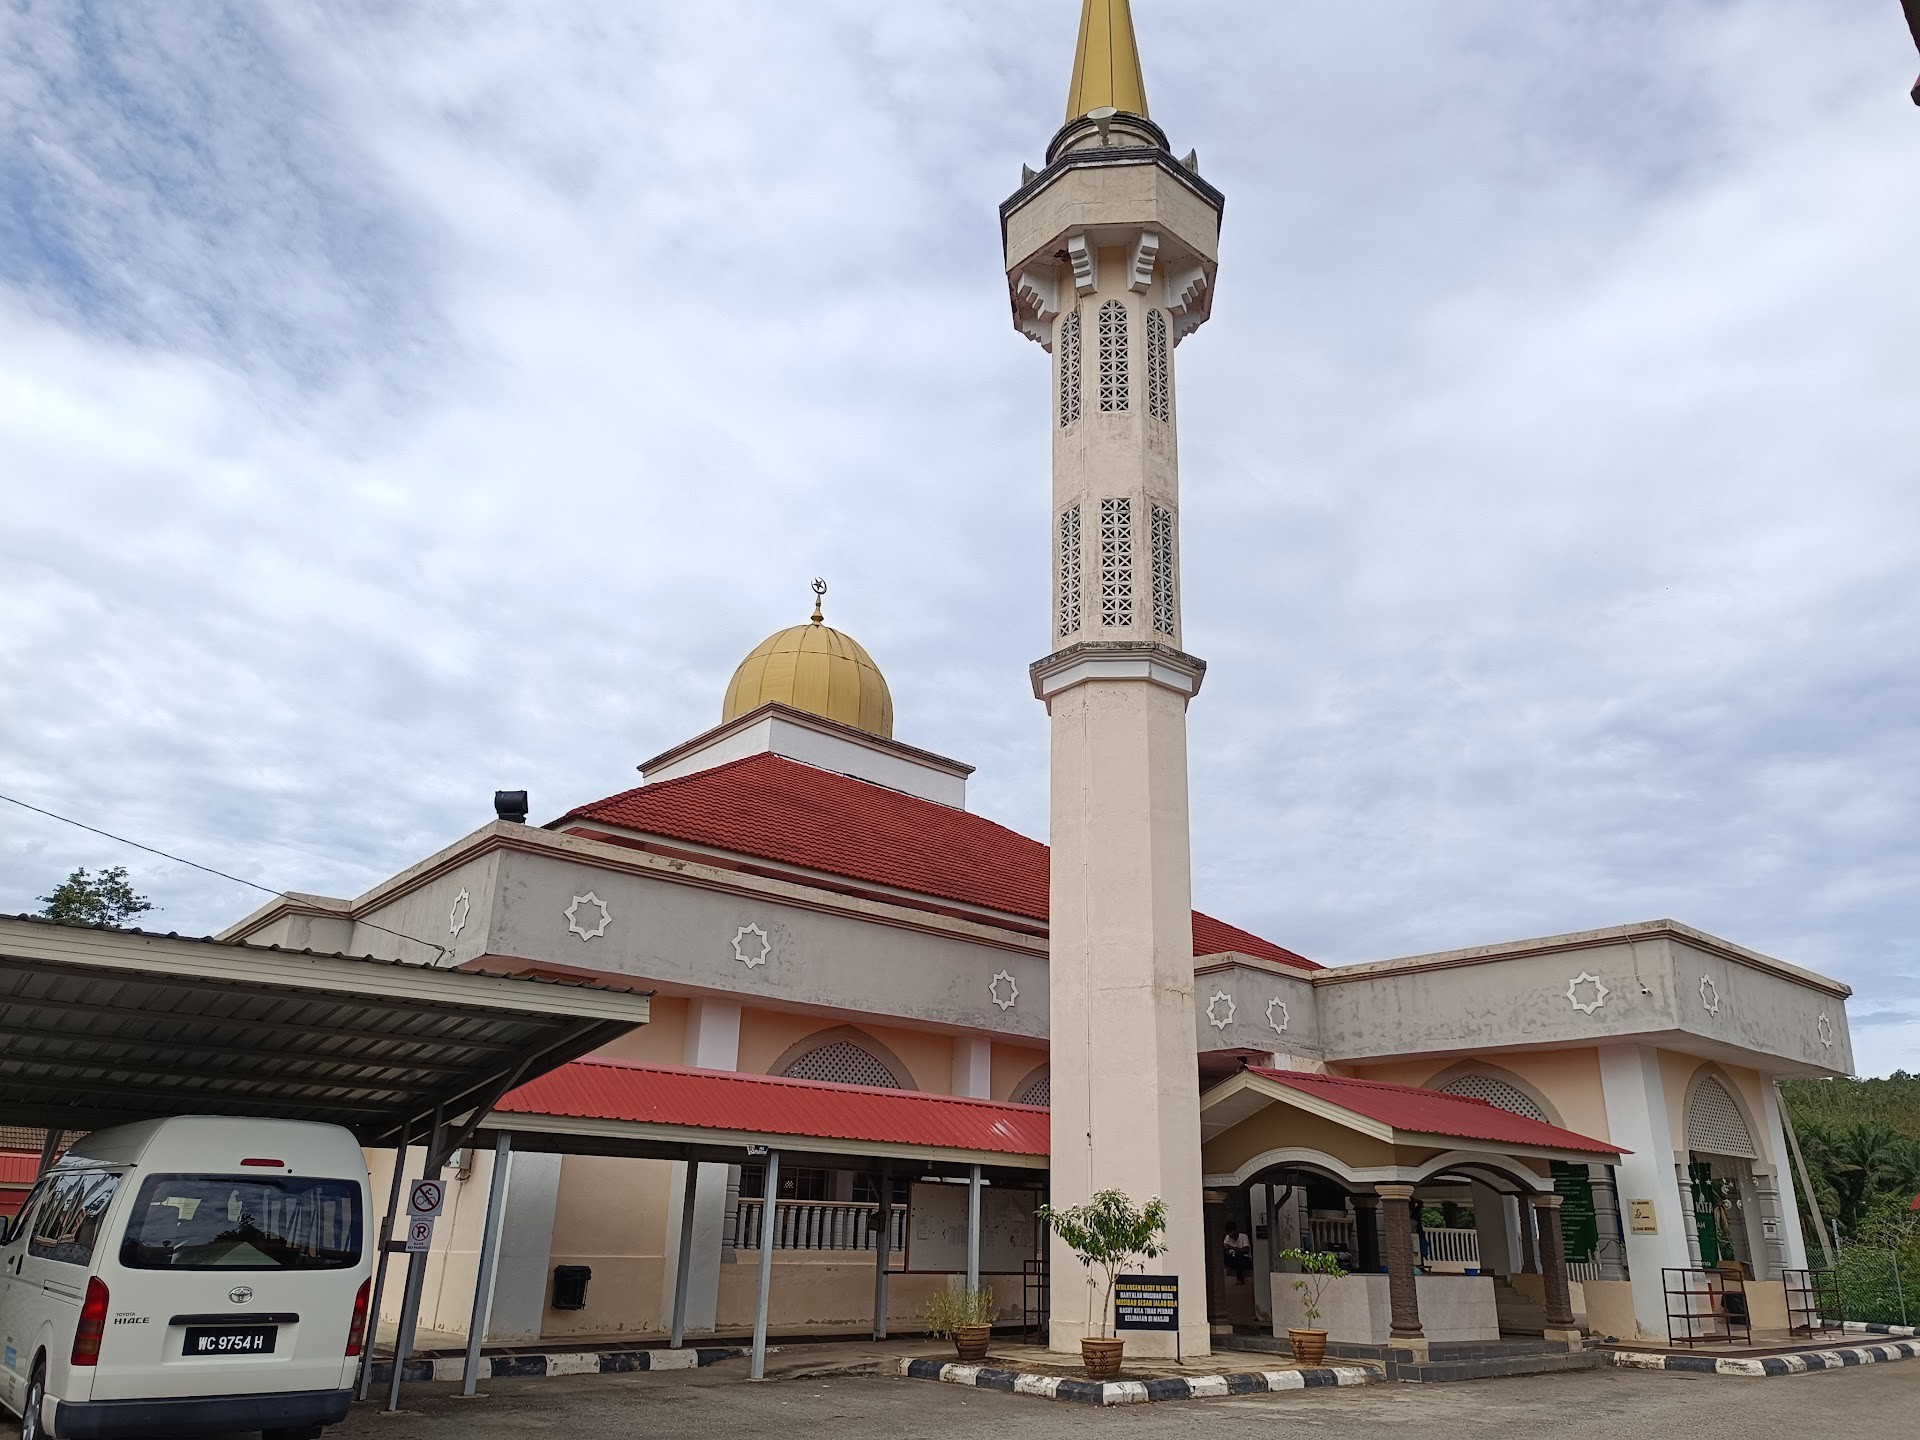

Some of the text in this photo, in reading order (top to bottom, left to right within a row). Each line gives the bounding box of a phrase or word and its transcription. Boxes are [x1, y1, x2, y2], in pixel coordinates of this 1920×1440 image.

[1695, 1201, 1714, 1214] KITA
[114, 1317, 150, 1325] HIACE
[198, 1335, 264, 1351] WC 9754 H
